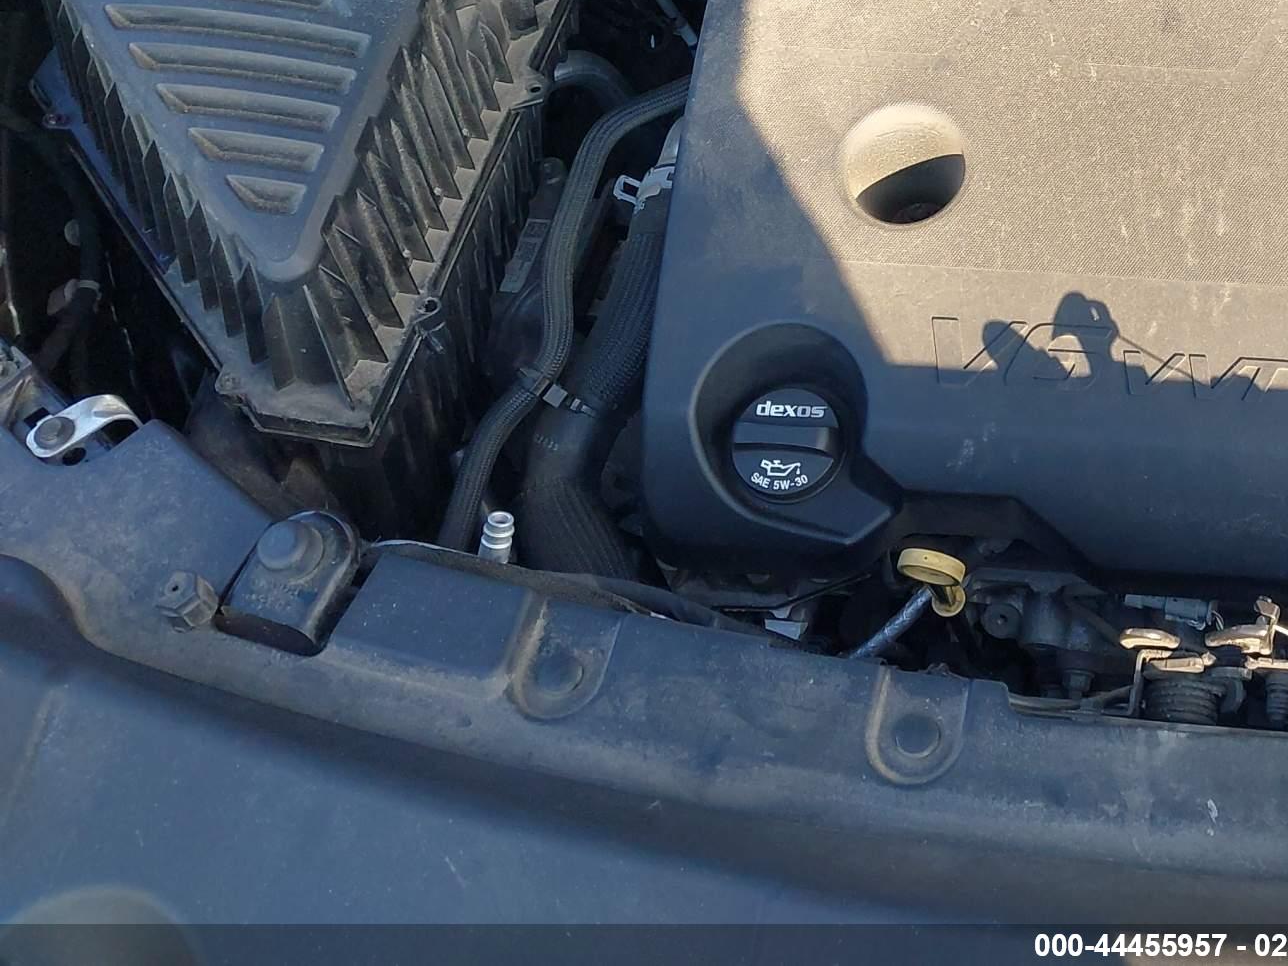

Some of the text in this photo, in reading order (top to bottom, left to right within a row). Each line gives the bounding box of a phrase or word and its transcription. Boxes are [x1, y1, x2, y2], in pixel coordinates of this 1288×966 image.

[756, 400, 828, 418] dexos
[751, 472, 808, 490] SAE 5W-30
